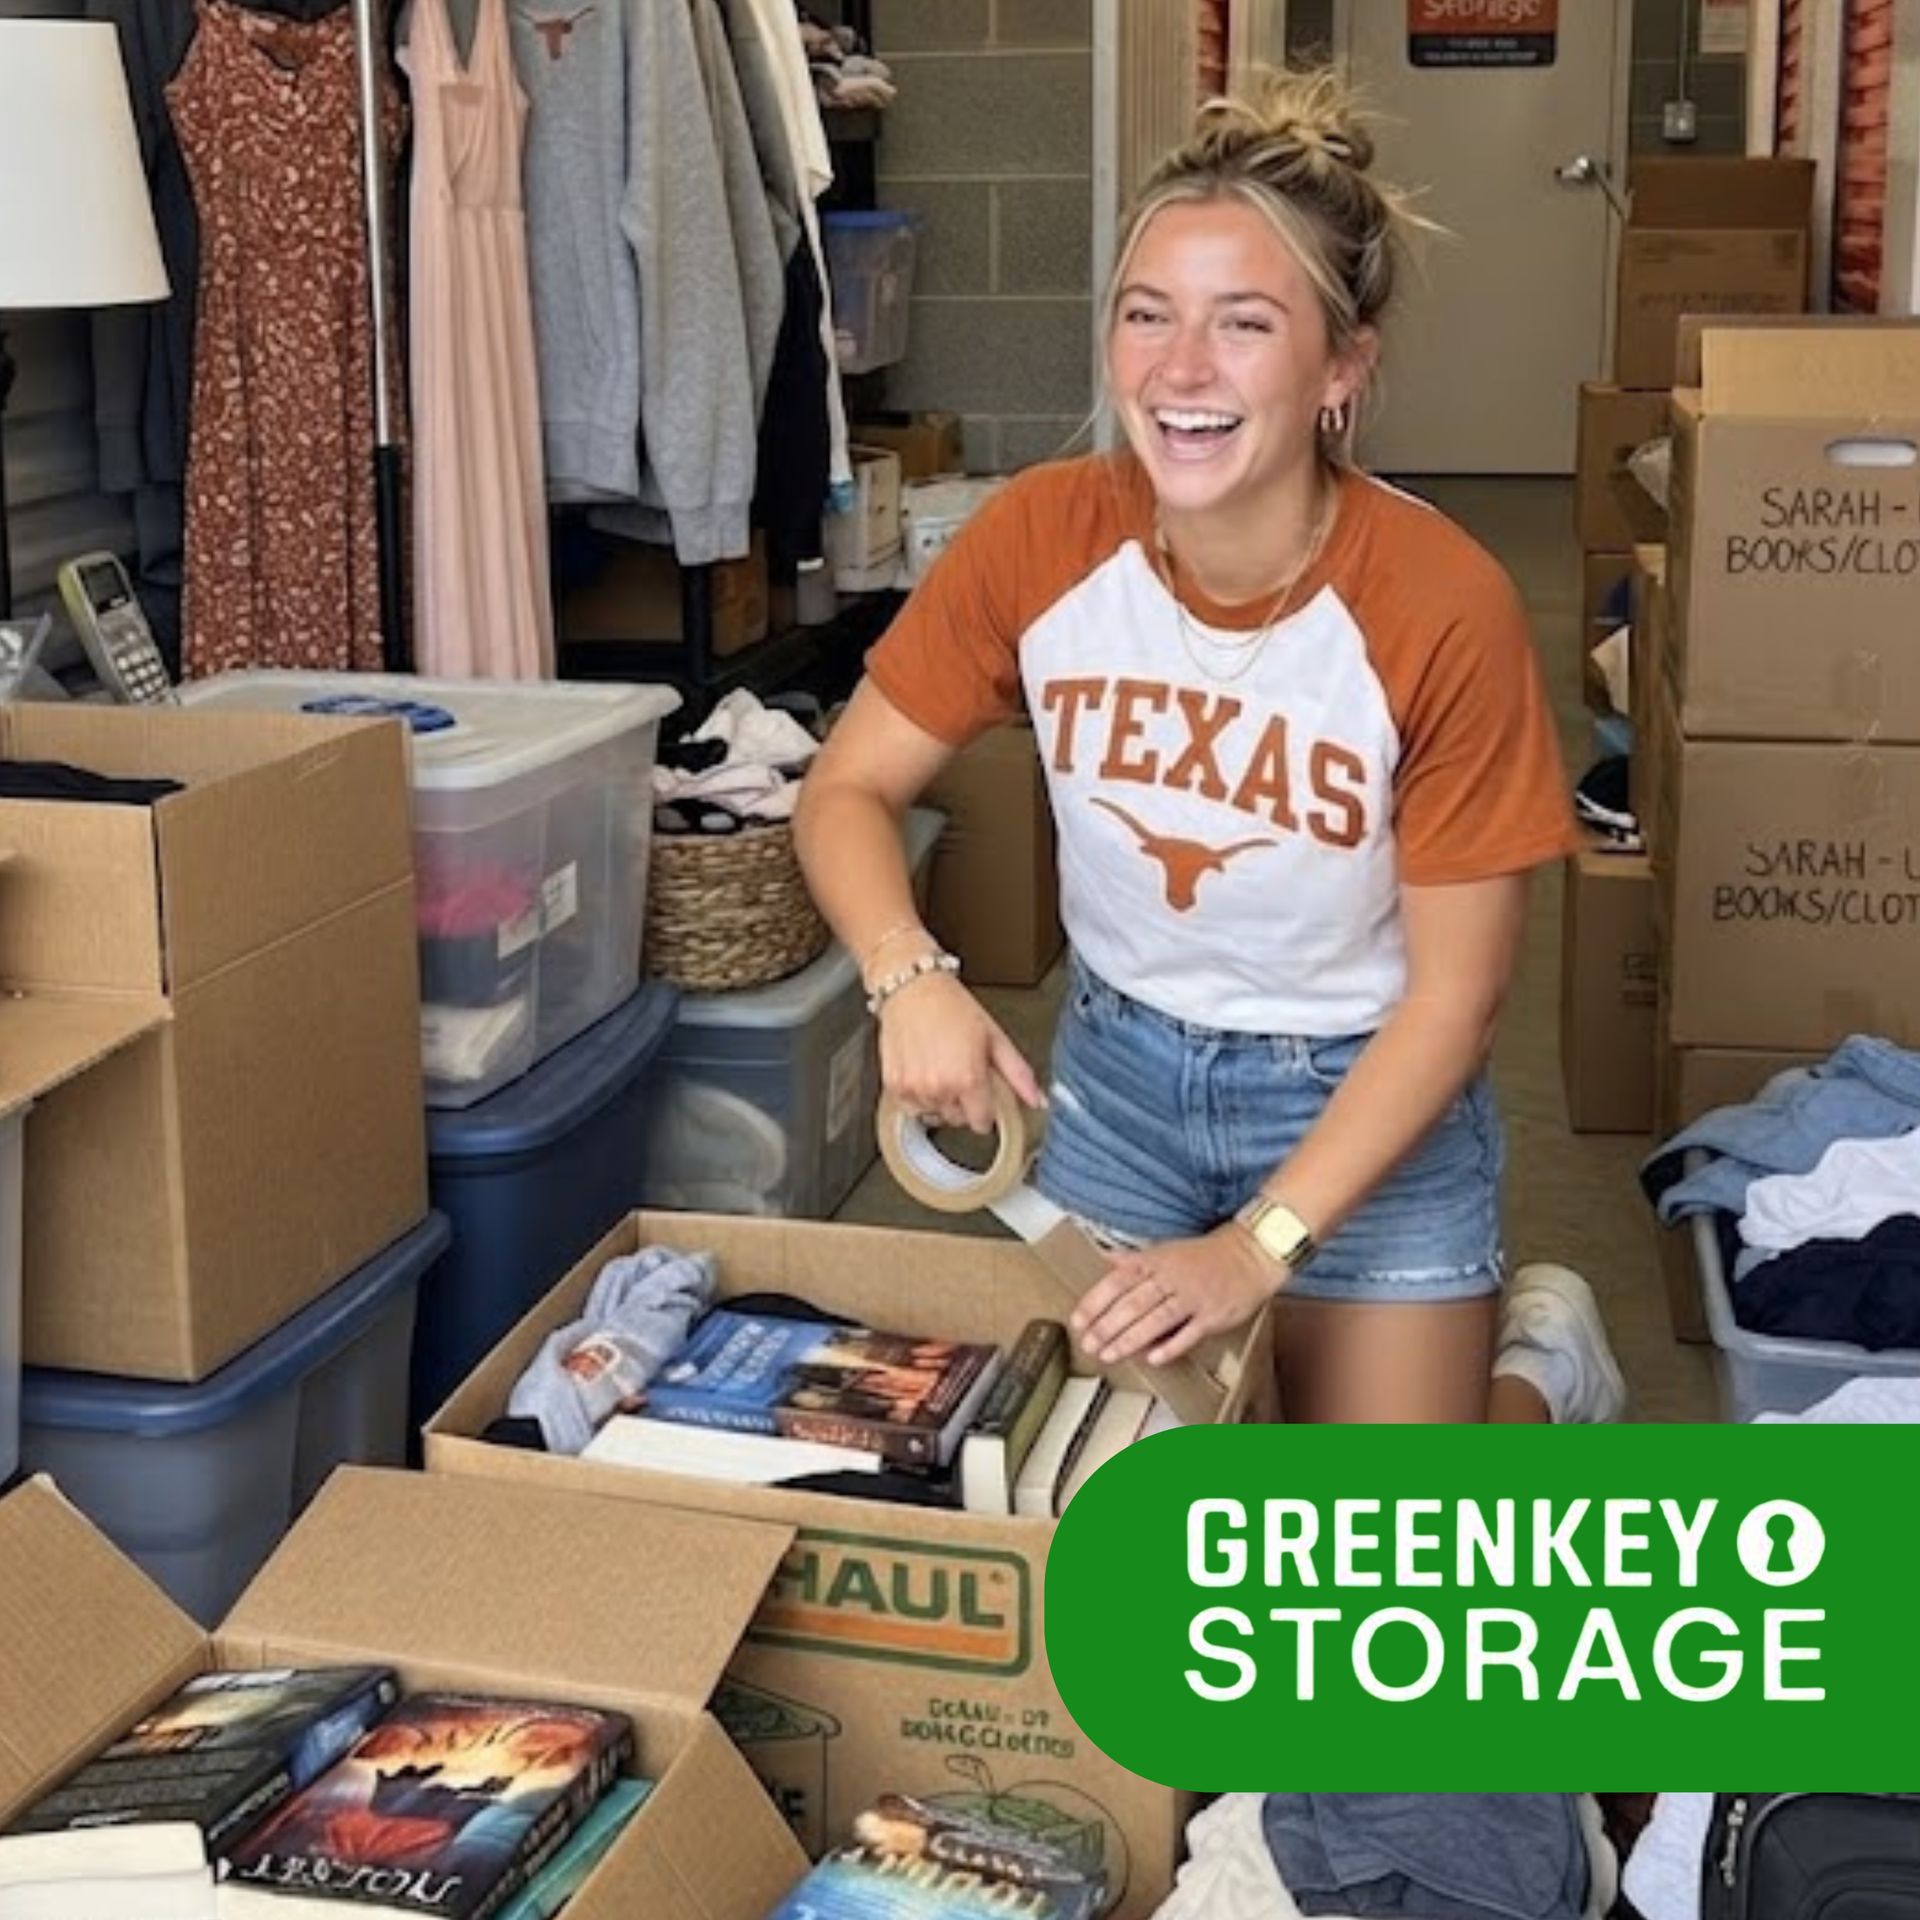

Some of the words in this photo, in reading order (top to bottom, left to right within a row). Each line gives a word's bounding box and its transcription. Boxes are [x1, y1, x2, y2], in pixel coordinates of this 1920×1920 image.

[1760, 487, 1880, 528] SARAH
[1727, 534, 1920, 574] BOOKS/CLO
[1043, 677, 1367, 849] TEXAS
[1744, 839, 1864, 879] SARAH
